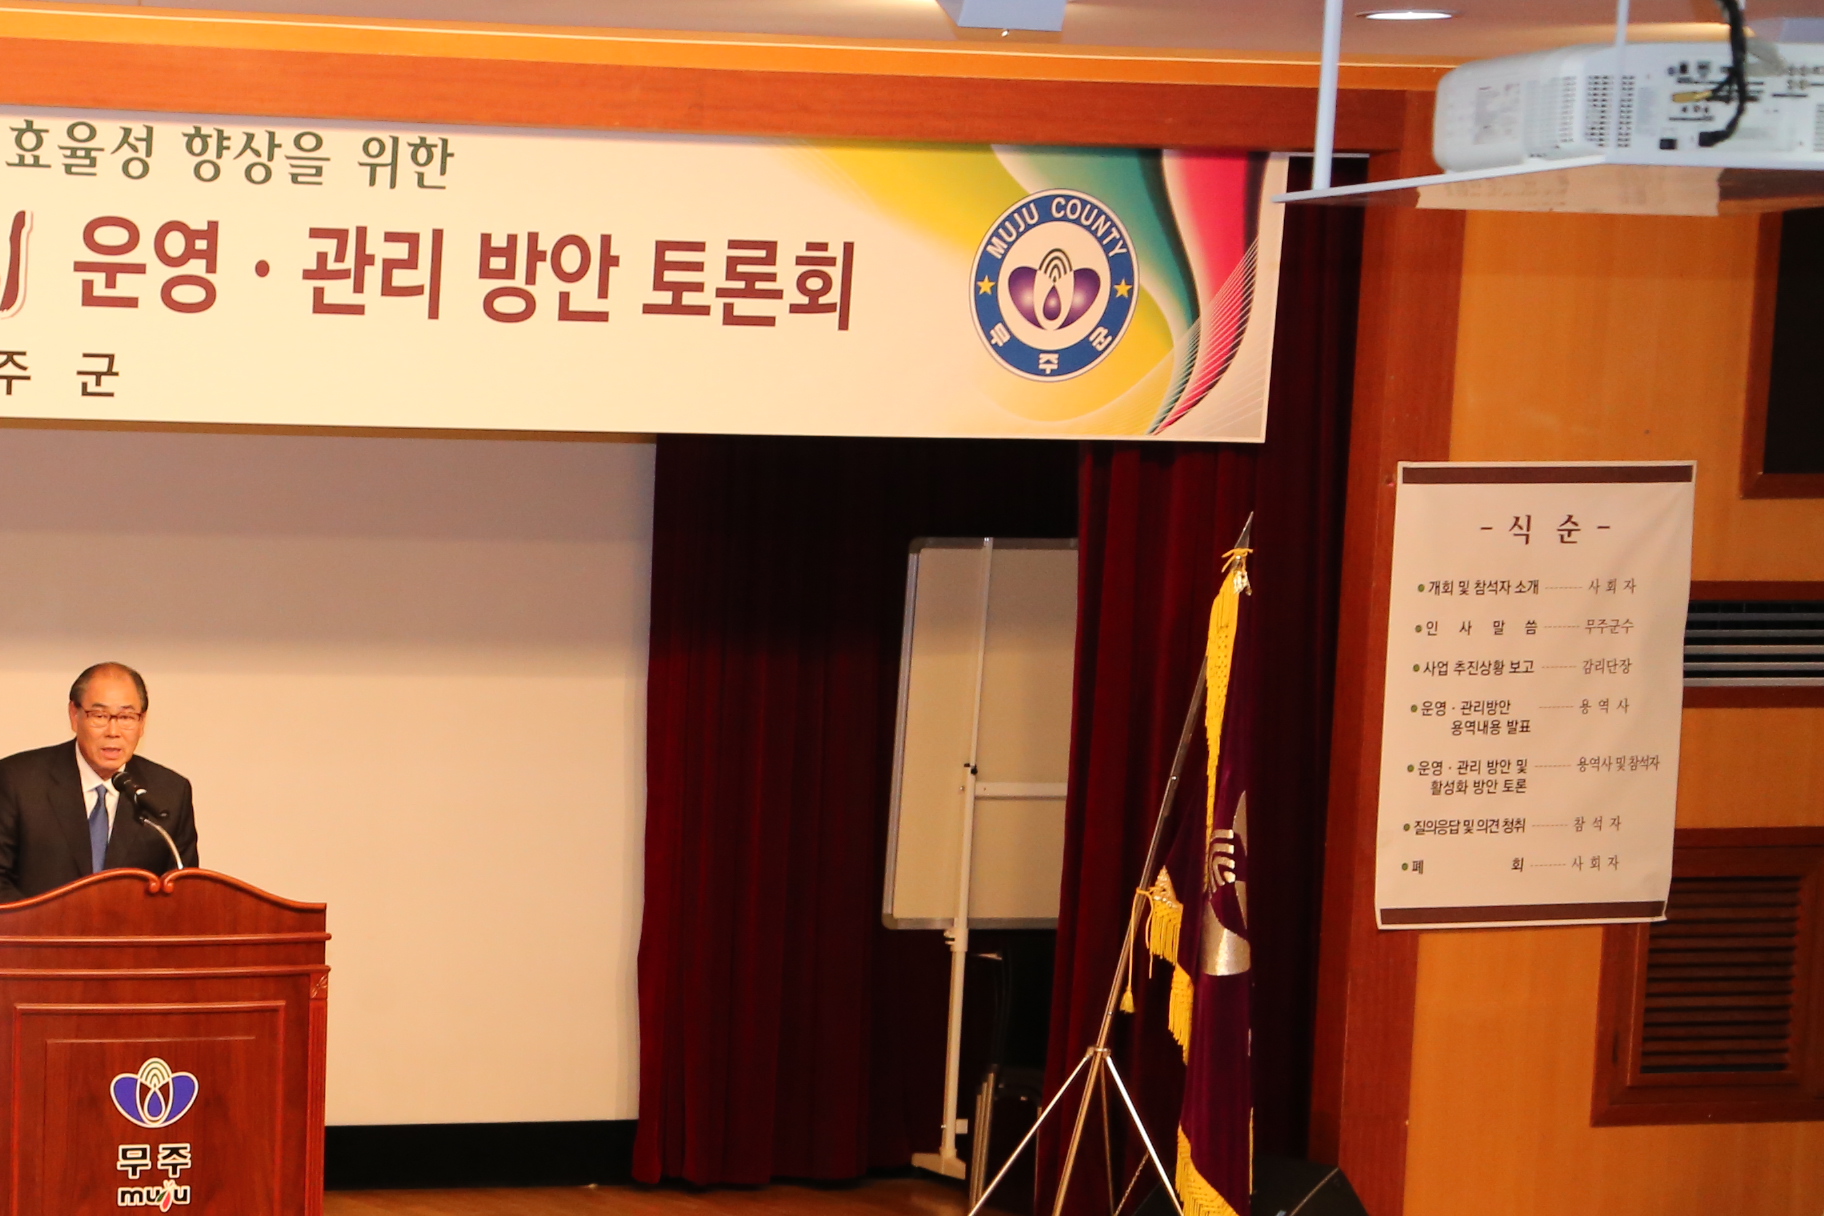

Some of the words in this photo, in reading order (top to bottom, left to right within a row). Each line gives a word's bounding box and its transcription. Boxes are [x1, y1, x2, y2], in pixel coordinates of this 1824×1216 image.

[5, 118, 155, 180] 효율성
[181, 125, 331, 186] 향상을
[357, 135, 455, 190] 위한
[986, 202, 1040, 260] MUJU
[1051, 196, 1128, 258] COUNTY
[73, 215, 219, 314] 운영
[301, 225, 445, 321] 관리
[478, 230, 621, 324] 방안
[641, 239, 856, 332] 토론회
[1428, 580, 1454, 596] 개회
[1458, 580, 1470, 596] 및
[1474, 579, 1511, 595] 참석자
[1514, 579, 1539, 595] 소개
[1584, 618, 1634, 634] 무주군수
[1423, 660, 1449, 676] 사업
[1453, 659, 1505, 676] 추진상황
[1508, 659, 1535, 674] 보고
[1582, 657, 1632, 675] 감리단장
[1421, 700, 1447, 717] 운영
[1460, 699, 1511, 716] 관리방안
[1451, 719, 1501, 736] 용역내용
[1506, 719, 1531, 735] 발표
[1418, 760, 1443, 776] 운영
[1457, 760, 1481, 775] 관리
[1487, 759, 1512, 775] 방안
[1516, 758, 1528, 775] 및
[1577, 755, 1613, 772] 용역사
[1616, 755, 1626, 772] 및
[1628, 754, 1661, 771] 참석자
[1430, 779, 1468, 796] 활성화
[1473, 779, 1499, 795] 방안
[1502, 778, 1527, 794] 토론
[1414, 819, 1461, 836] 질의응답
[1463, 819, 1474, 835] 및
[1476, 818, 1500, 834] 의견
[1502, 817, 1526, 834] 청취
[116, 1142, 192, 1180] 무주
